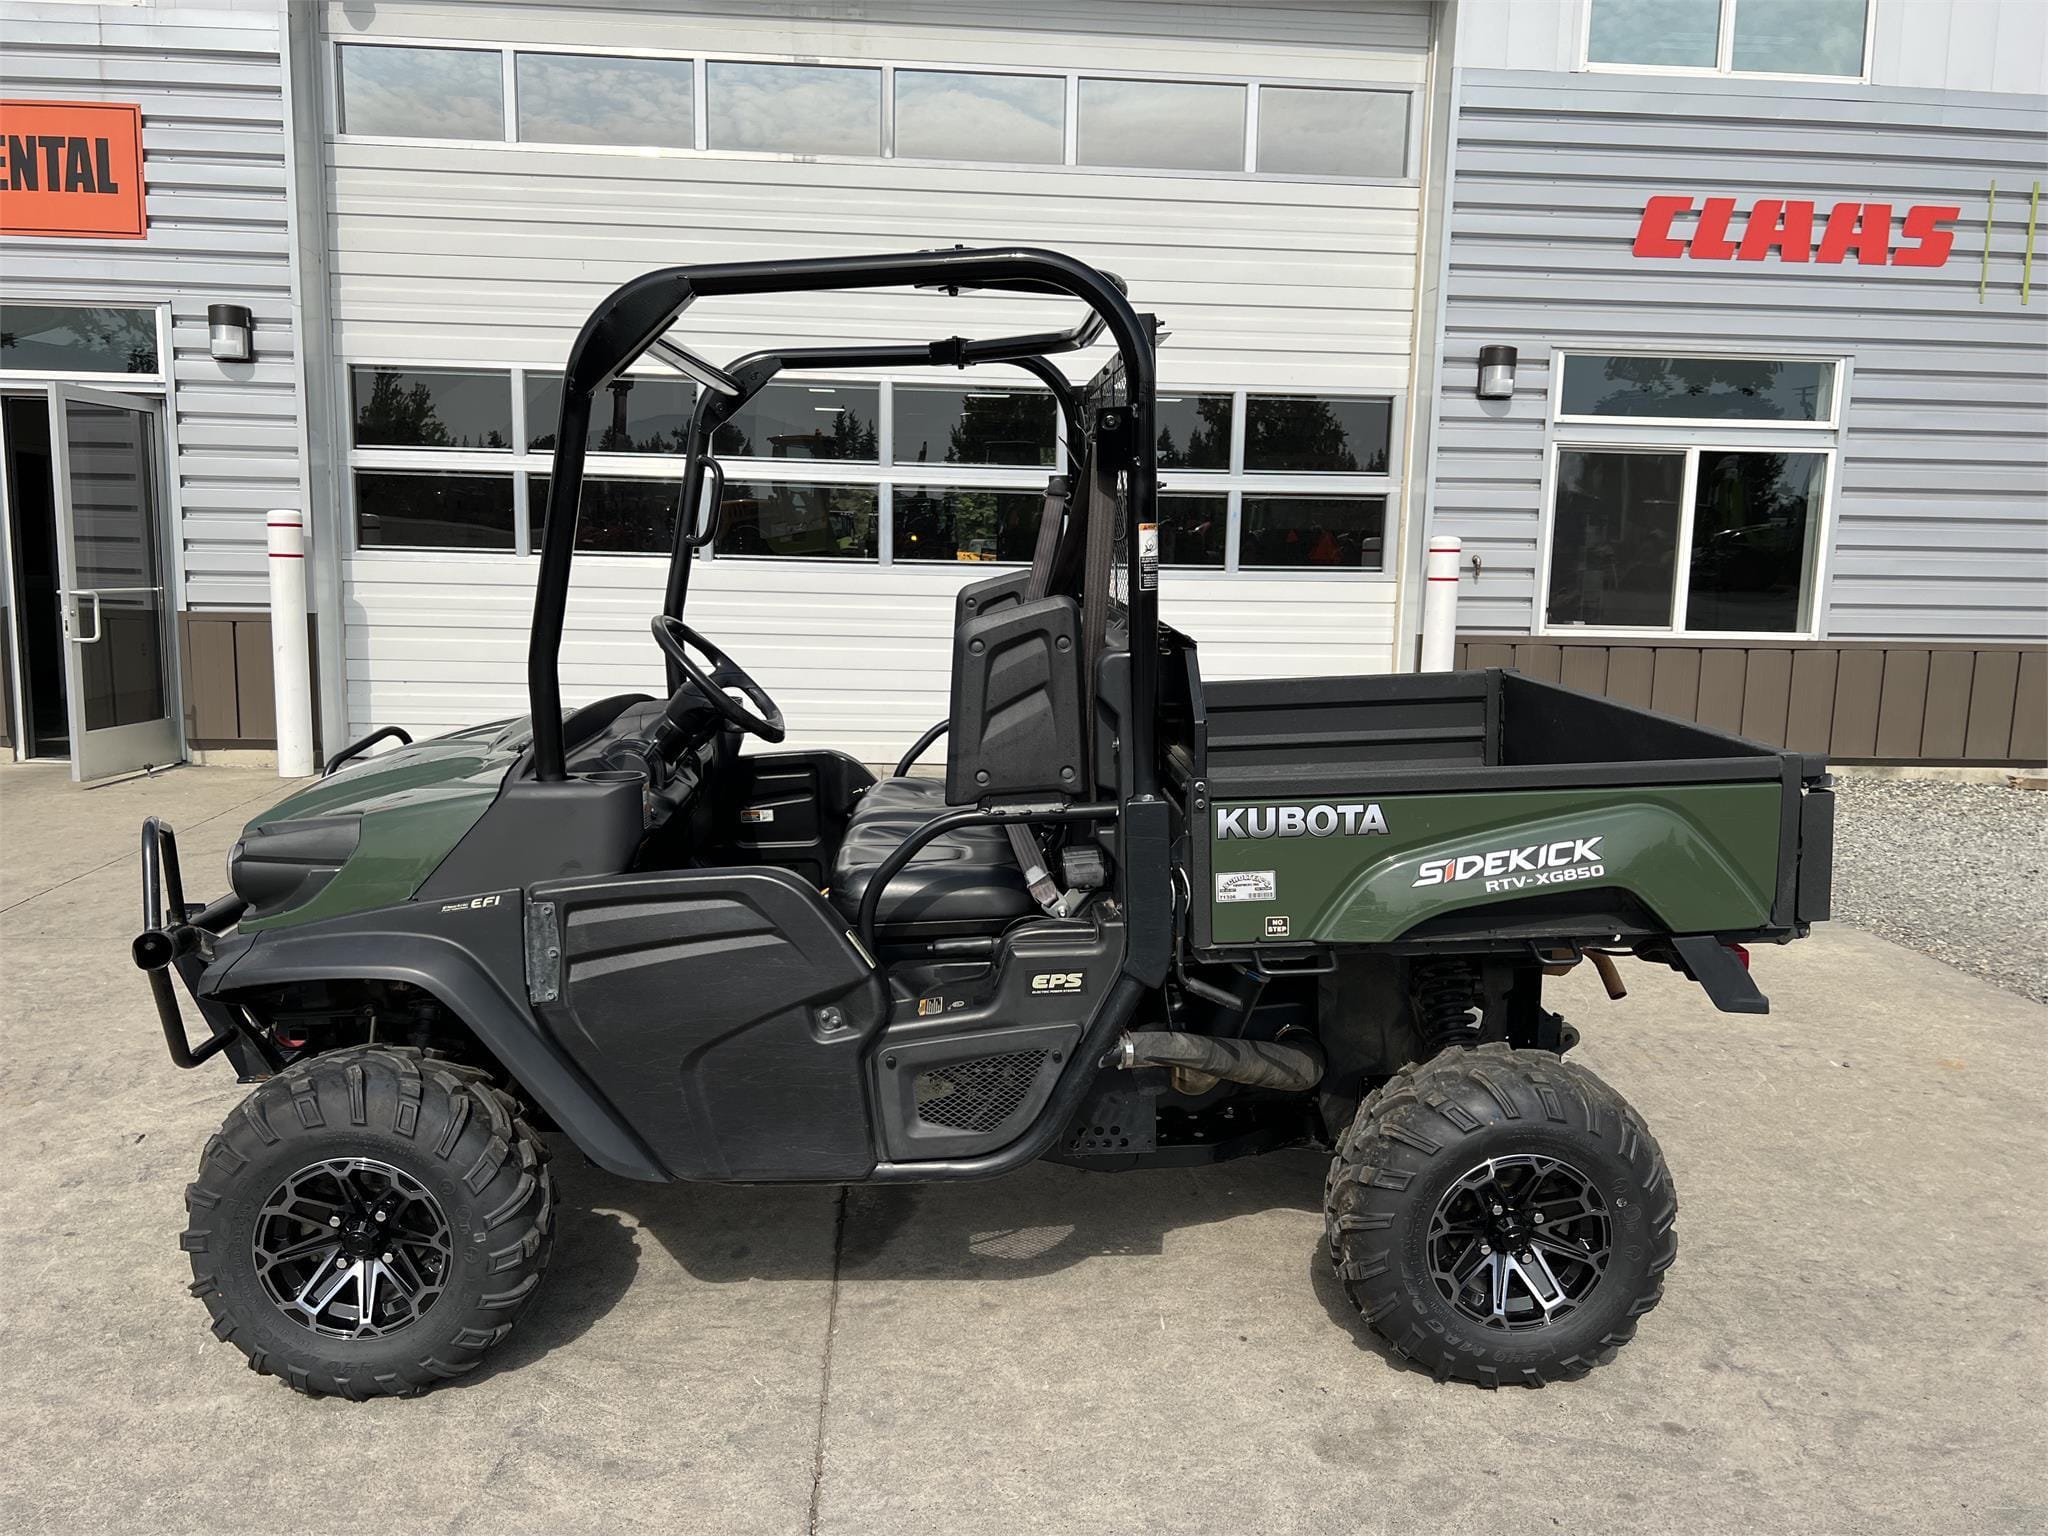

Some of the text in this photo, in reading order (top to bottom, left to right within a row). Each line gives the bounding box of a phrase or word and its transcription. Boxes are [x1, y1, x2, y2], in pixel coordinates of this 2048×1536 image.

[1632, 195, 1961, 267] CLAAS
[1217, 803, 1390, 840] KUBOTA
[1411, 836, 1604, 888] SIDEKICK
[1486, 864, 1605, 893] RTV-XG850
[471, 895, 500, 908] EFI
[1032, 973, 1083, 989] EPS
